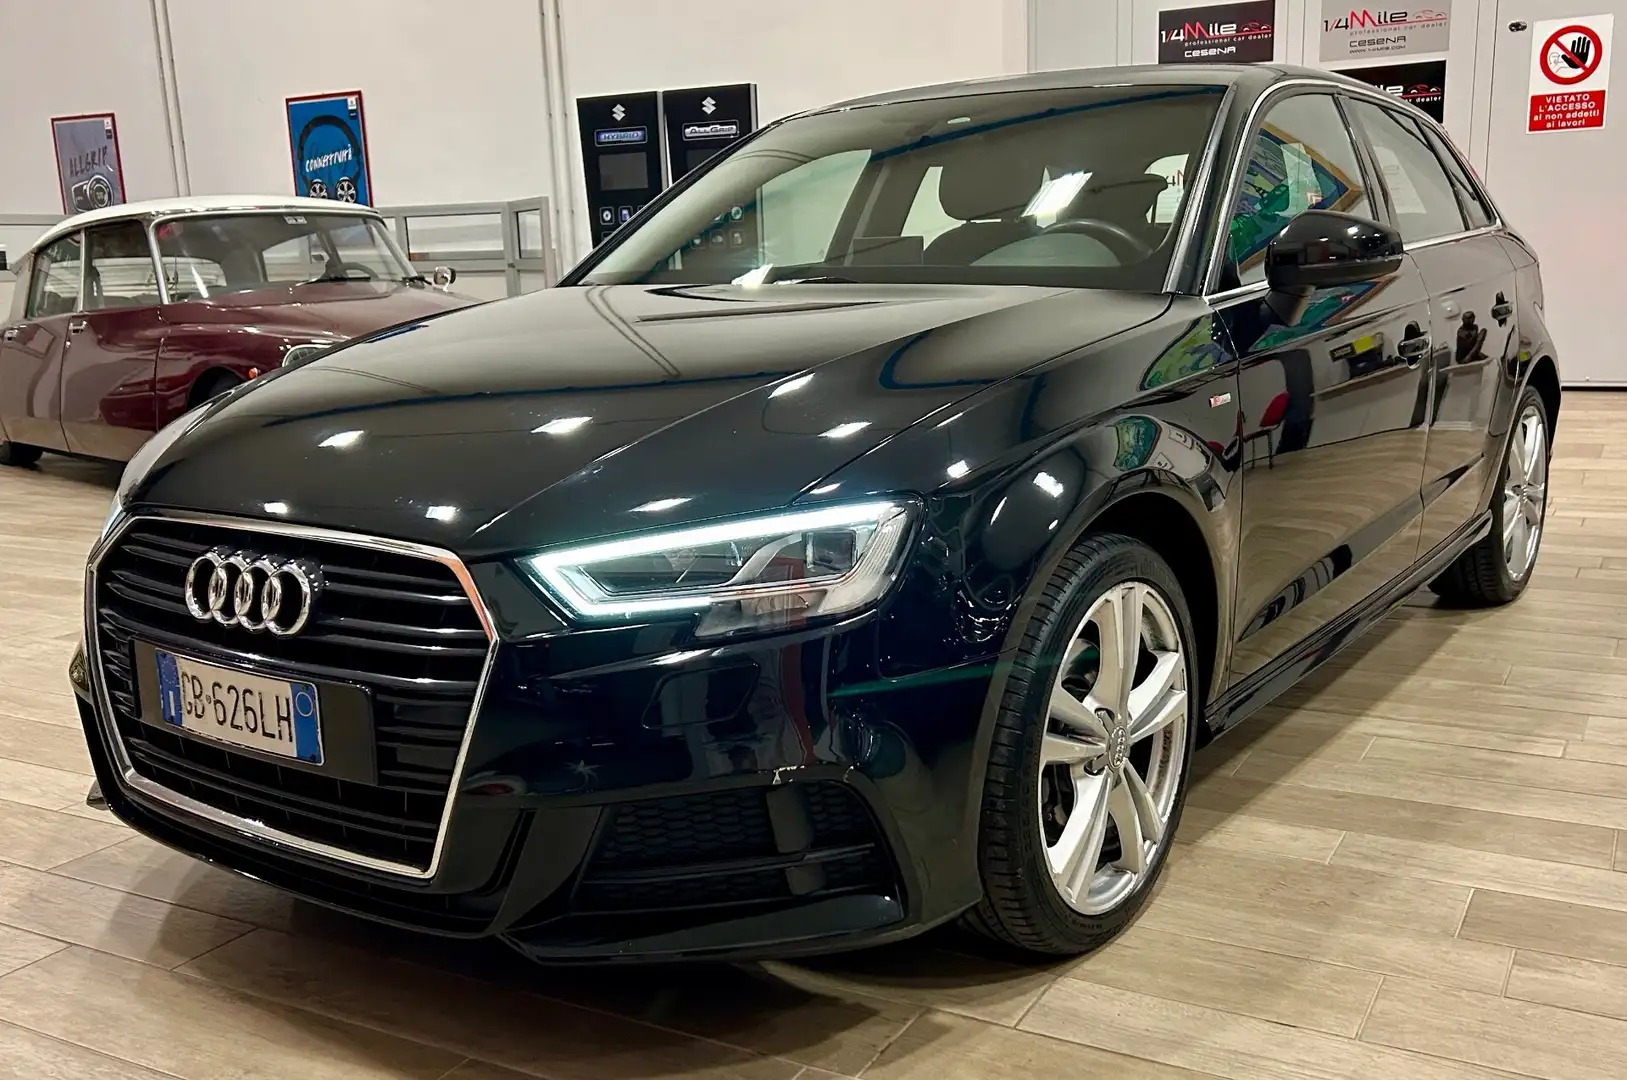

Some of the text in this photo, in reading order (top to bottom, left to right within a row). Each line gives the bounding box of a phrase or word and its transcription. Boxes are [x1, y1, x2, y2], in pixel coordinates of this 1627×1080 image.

[1349, 26, 1401, 36] professional
[1421, 21, 1448, 29] dealer
[1184, 37, 1231, 47] professional
[1248, 33, 1272, 41] dealer
[1546, 94, 1590, 104] VIETATO
[1539, 101, 1596, 113] L'ACCESSO
[1533, 109, 1600, 121] ai non addetti
[1558, 118, 1586, 127] lavori
